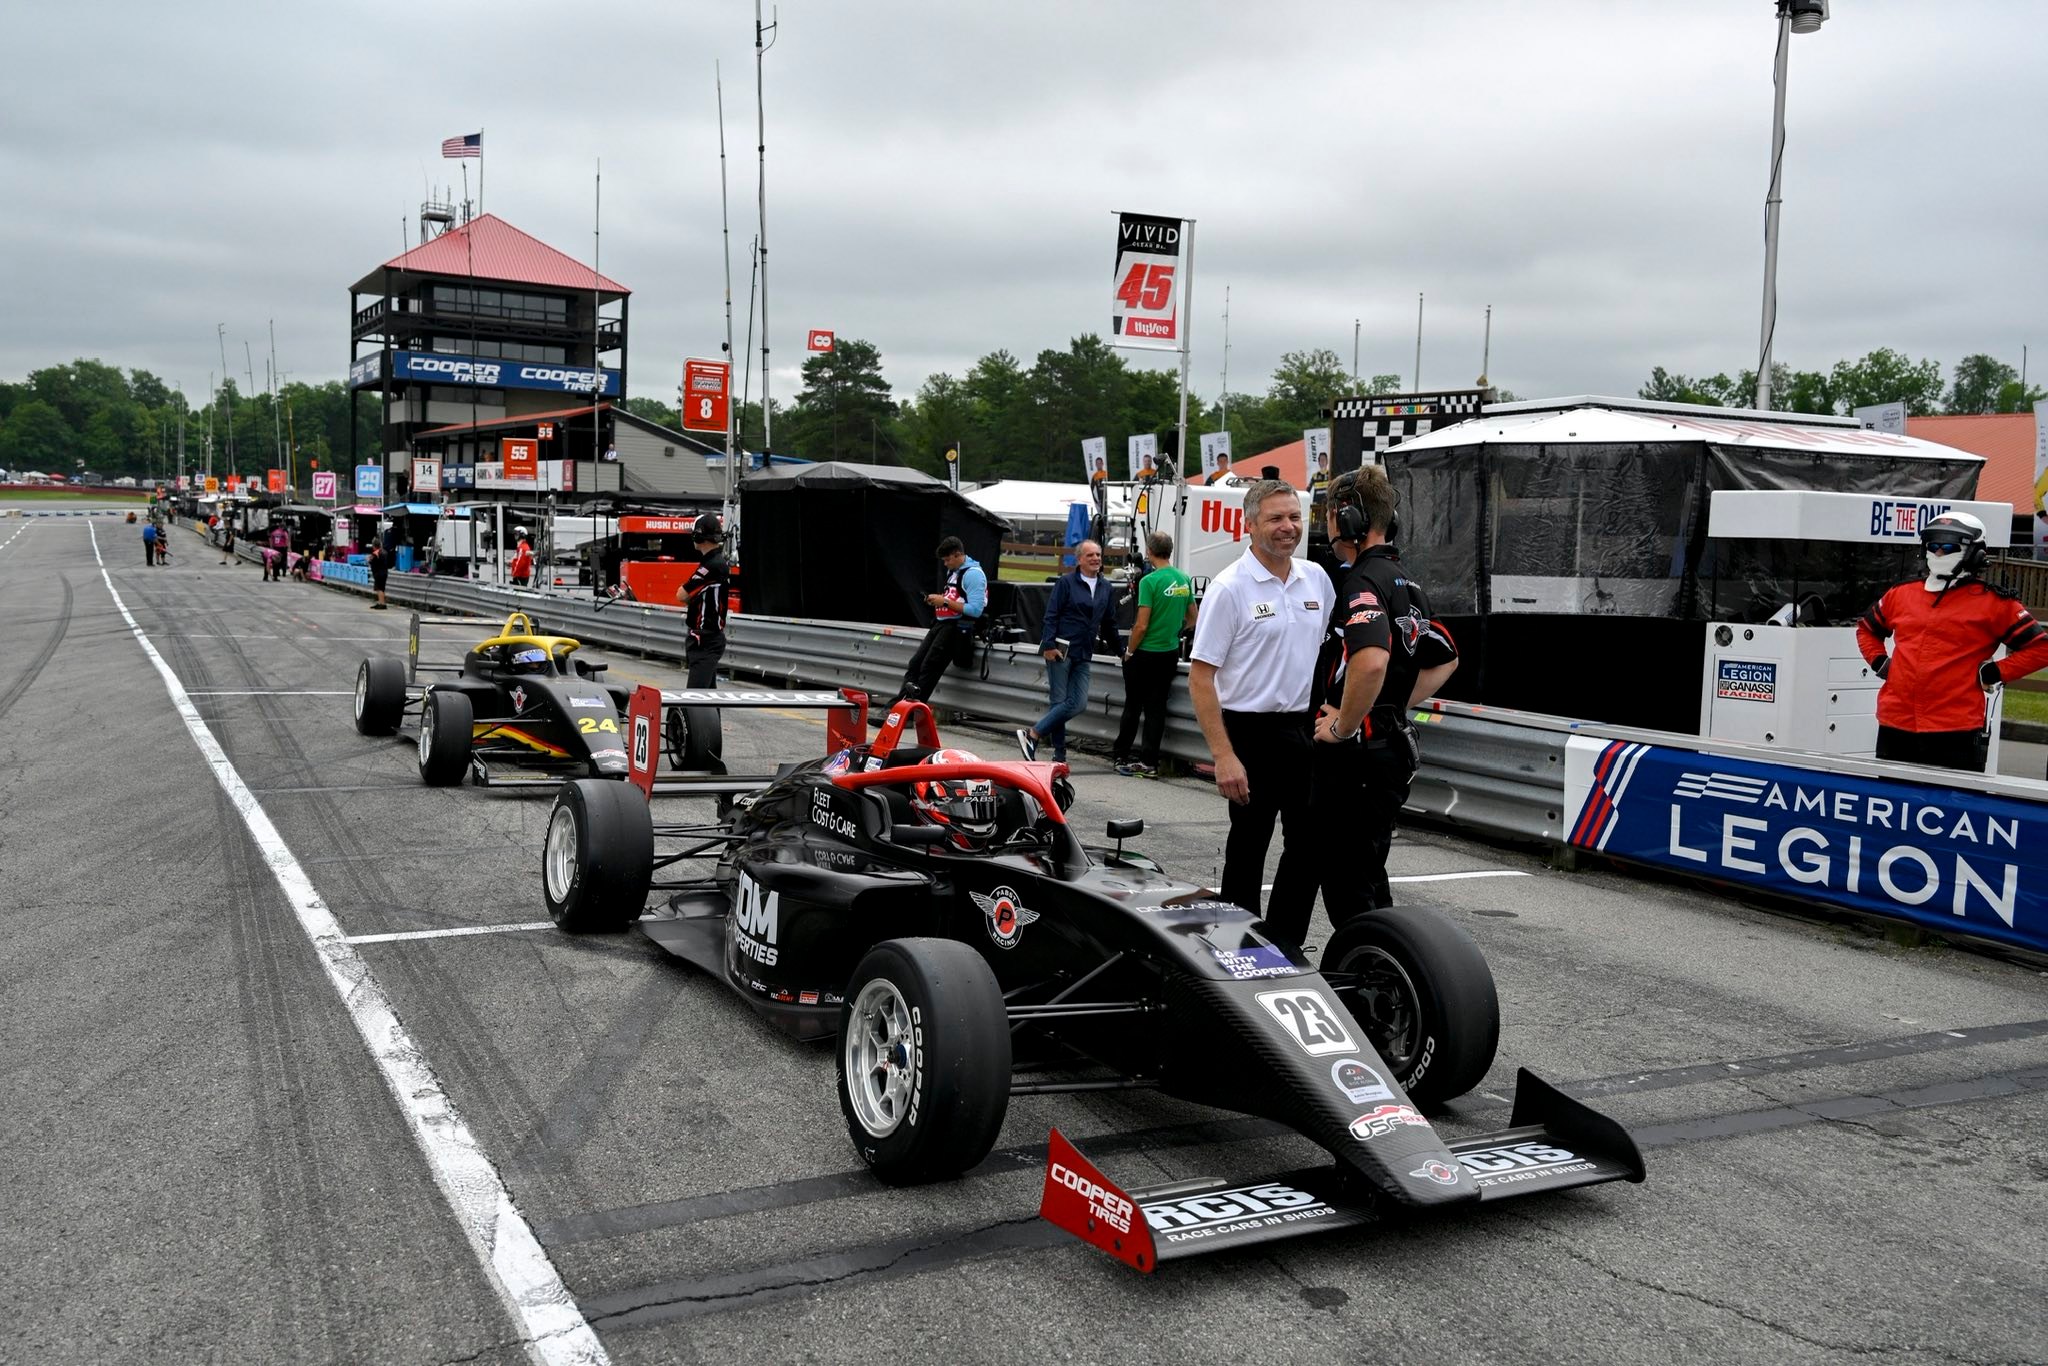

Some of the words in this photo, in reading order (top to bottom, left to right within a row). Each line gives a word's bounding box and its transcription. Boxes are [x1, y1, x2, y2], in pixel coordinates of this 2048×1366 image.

[1121, 222, 1179, 244] VIVID
[1116, 262, 1175, 310] 45
[1134, 321, 1169, 335] HyVee
[407, 357, 501, 376] COOPER
[520, 367, 609, 384] COOPER
[452, 372, 498, 384] TIRES
[701, 398, 712, 418] 8
[538, 427, 552, 438] 55
[511, 446, 528, 460] 55
[1310, 435, 1318, 462] HERTA
[422, 465, 433, 475] 14
[316, 477, 333, 495] 27
[358, 471, 380, 490] 29
[646, 520, 670, 530] HUSKI
[1871, 501, 1894, 536] BE
[1896, 509, 1916, 531] THE
[1722, 669, 1772, 682] LEGION
[1719, 690, 1773, 700] RACING
[1729, 682, 1773, 693] GANASSI
[578, 718, 618, 734] 24
[635, 723, 647, 764] 23
[813, 787, 831, 808] FLEET
[812, 805, 829, 827] COST
[829, 812, 836, 830] &
[836, 816, 856, 839] CARE
[1763, 782, 2018, 850] AMERICAN
[1670, 803, 2018, 929] LEGION
[996, 889, 1017, 901] PABST
[997, 908, 1012, 926] P
[992, 931, 1016, 946] RACING
[1219, 956, 1257, 965] WITH
[1226, 963, 1254, 972] THE
[1233, 966, 1299, 979] COOPERS.
[1274, 996, 1346, 1046] 23
[908, 1006, 923, 1127] COOPER
[1400, 1036, 1435, 1093] COOPE
[1352, 1116, 1401, 1139] USF
[1498, 1171, 1536, 1183] CARS
[1538, 1169, 1552, 1177] IN
[1554, 1162, 1597, 1175] SHEDS
[1051, 1162, 1134, 1221] COOPER
[1088, 1200, 1130, 1234] TIRES
[1166, 1225, 1218, 1243] RACE
[1219, 1219, 1263, 1235] CARS
[1264, 1215, 1281, 1227] IN
[1282, 1206, 1336, 1223] SHEDS
